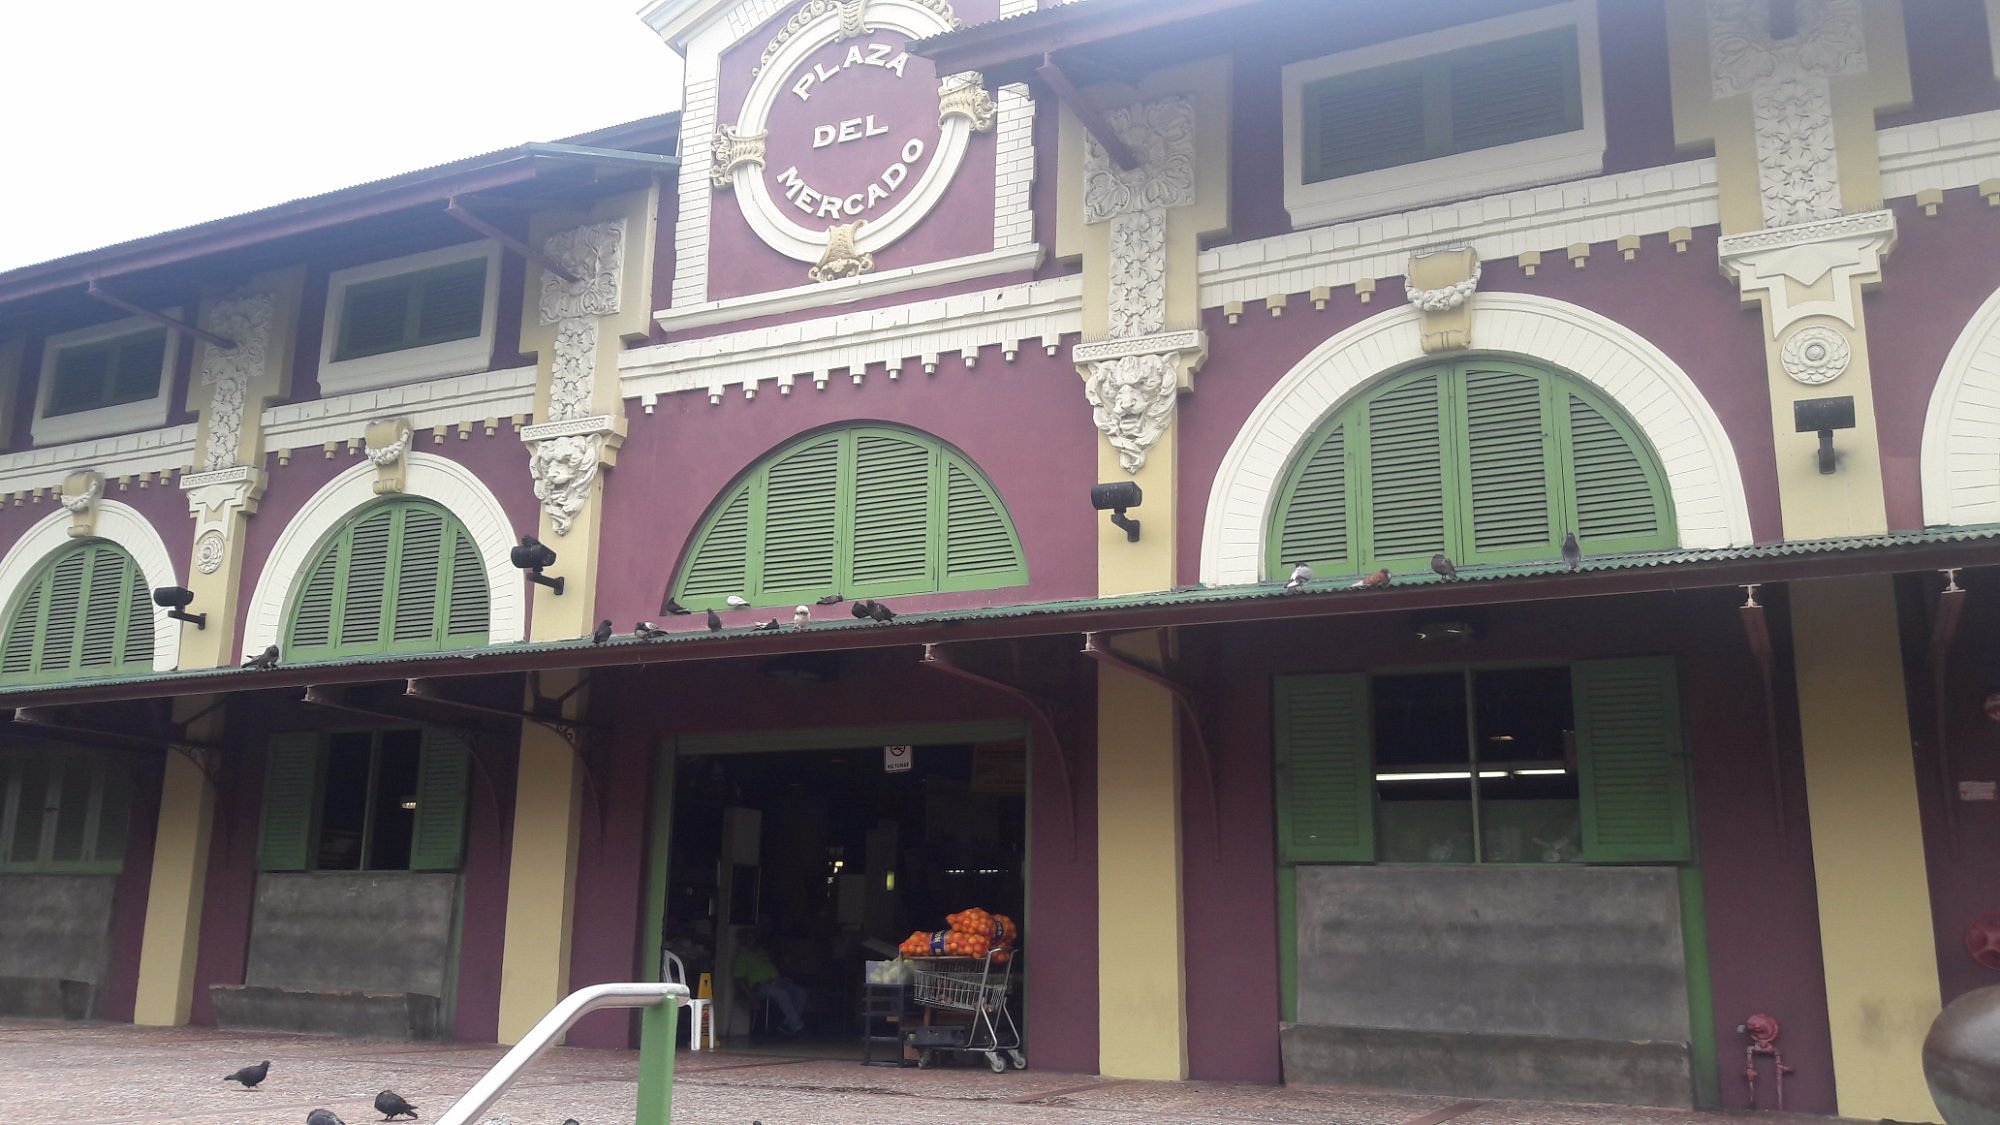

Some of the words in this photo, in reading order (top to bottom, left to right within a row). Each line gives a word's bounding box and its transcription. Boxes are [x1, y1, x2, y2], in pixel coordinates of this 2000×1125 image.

[791, 43, 910, 101] PLAZA
[812, 114, 889, 149] DEL
[776, 138, 925, 219] MERCADO
